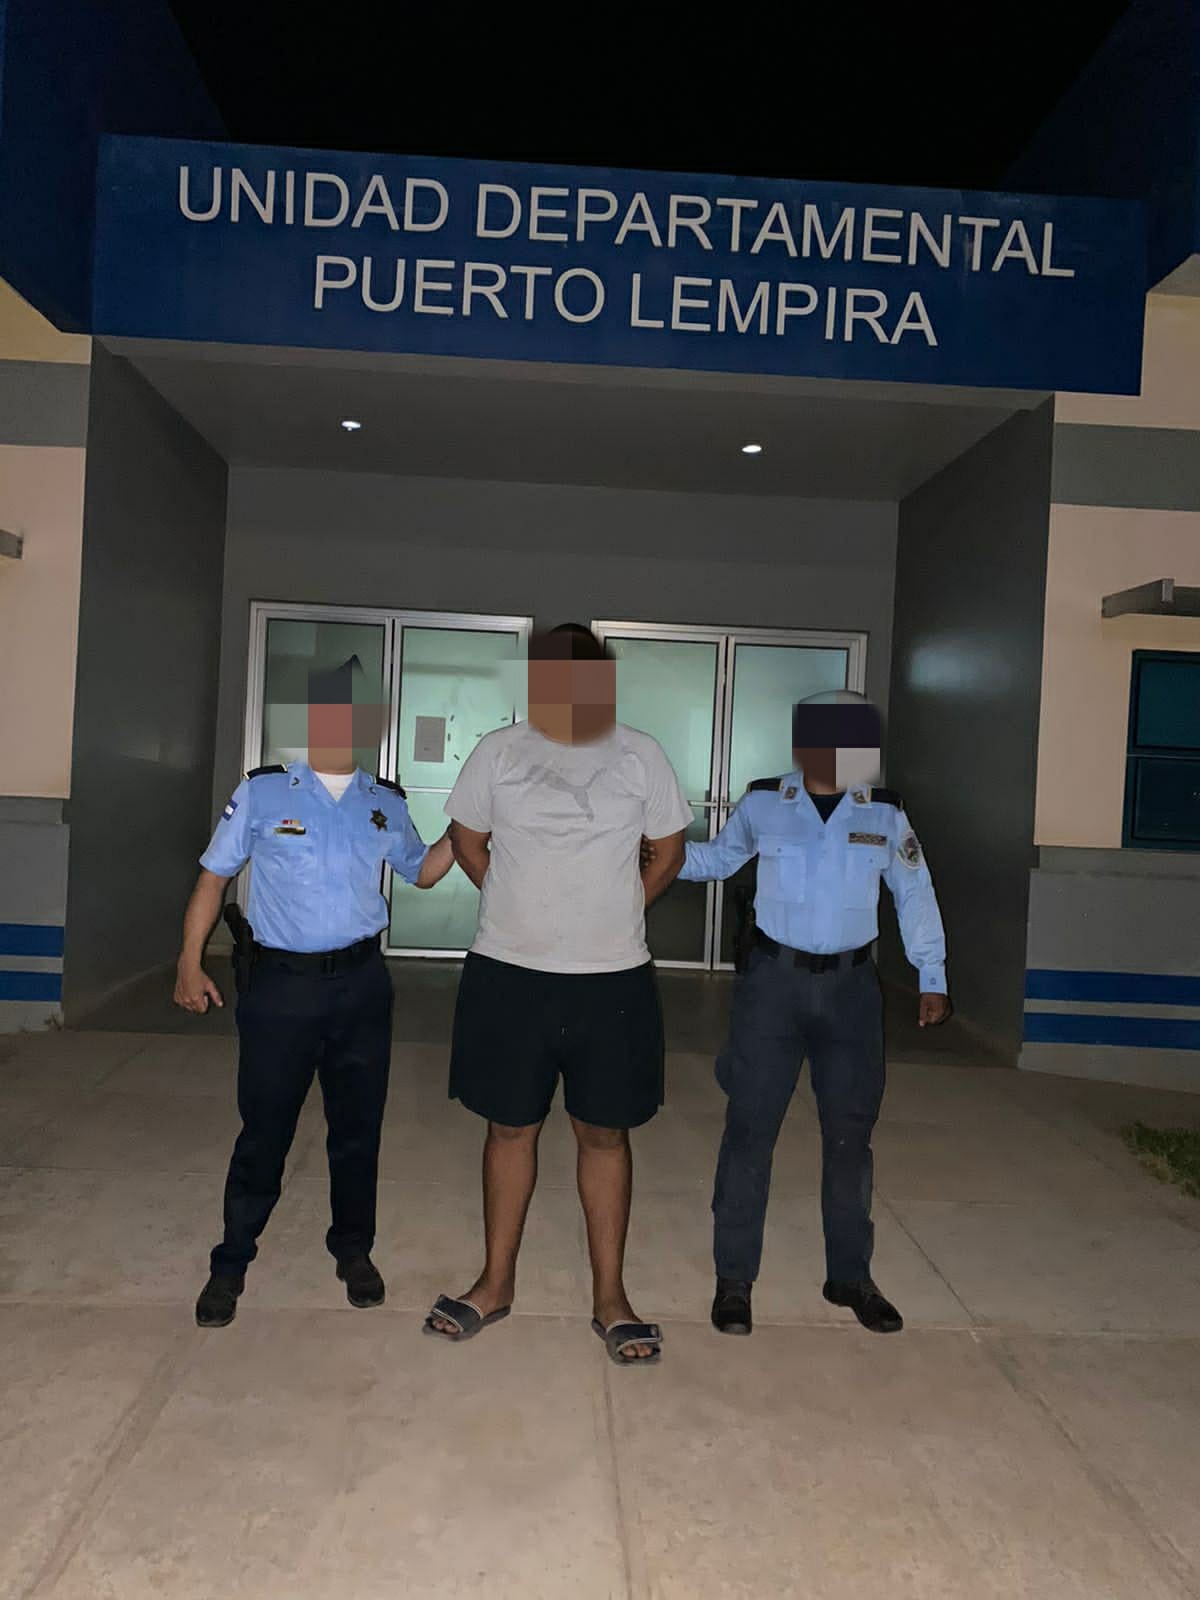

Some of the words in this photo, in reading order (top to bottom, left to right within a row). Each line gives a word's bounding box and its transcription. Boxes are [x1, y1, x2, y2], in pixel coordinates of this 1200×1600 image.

[178, 166, 449, 232] UNIDAD
[476, 183, 1075, 278] DEPARTAMENTAL
[314, 255, 605, 324] PUERTO
[630, 272, 938, 347] LEMPIRA
